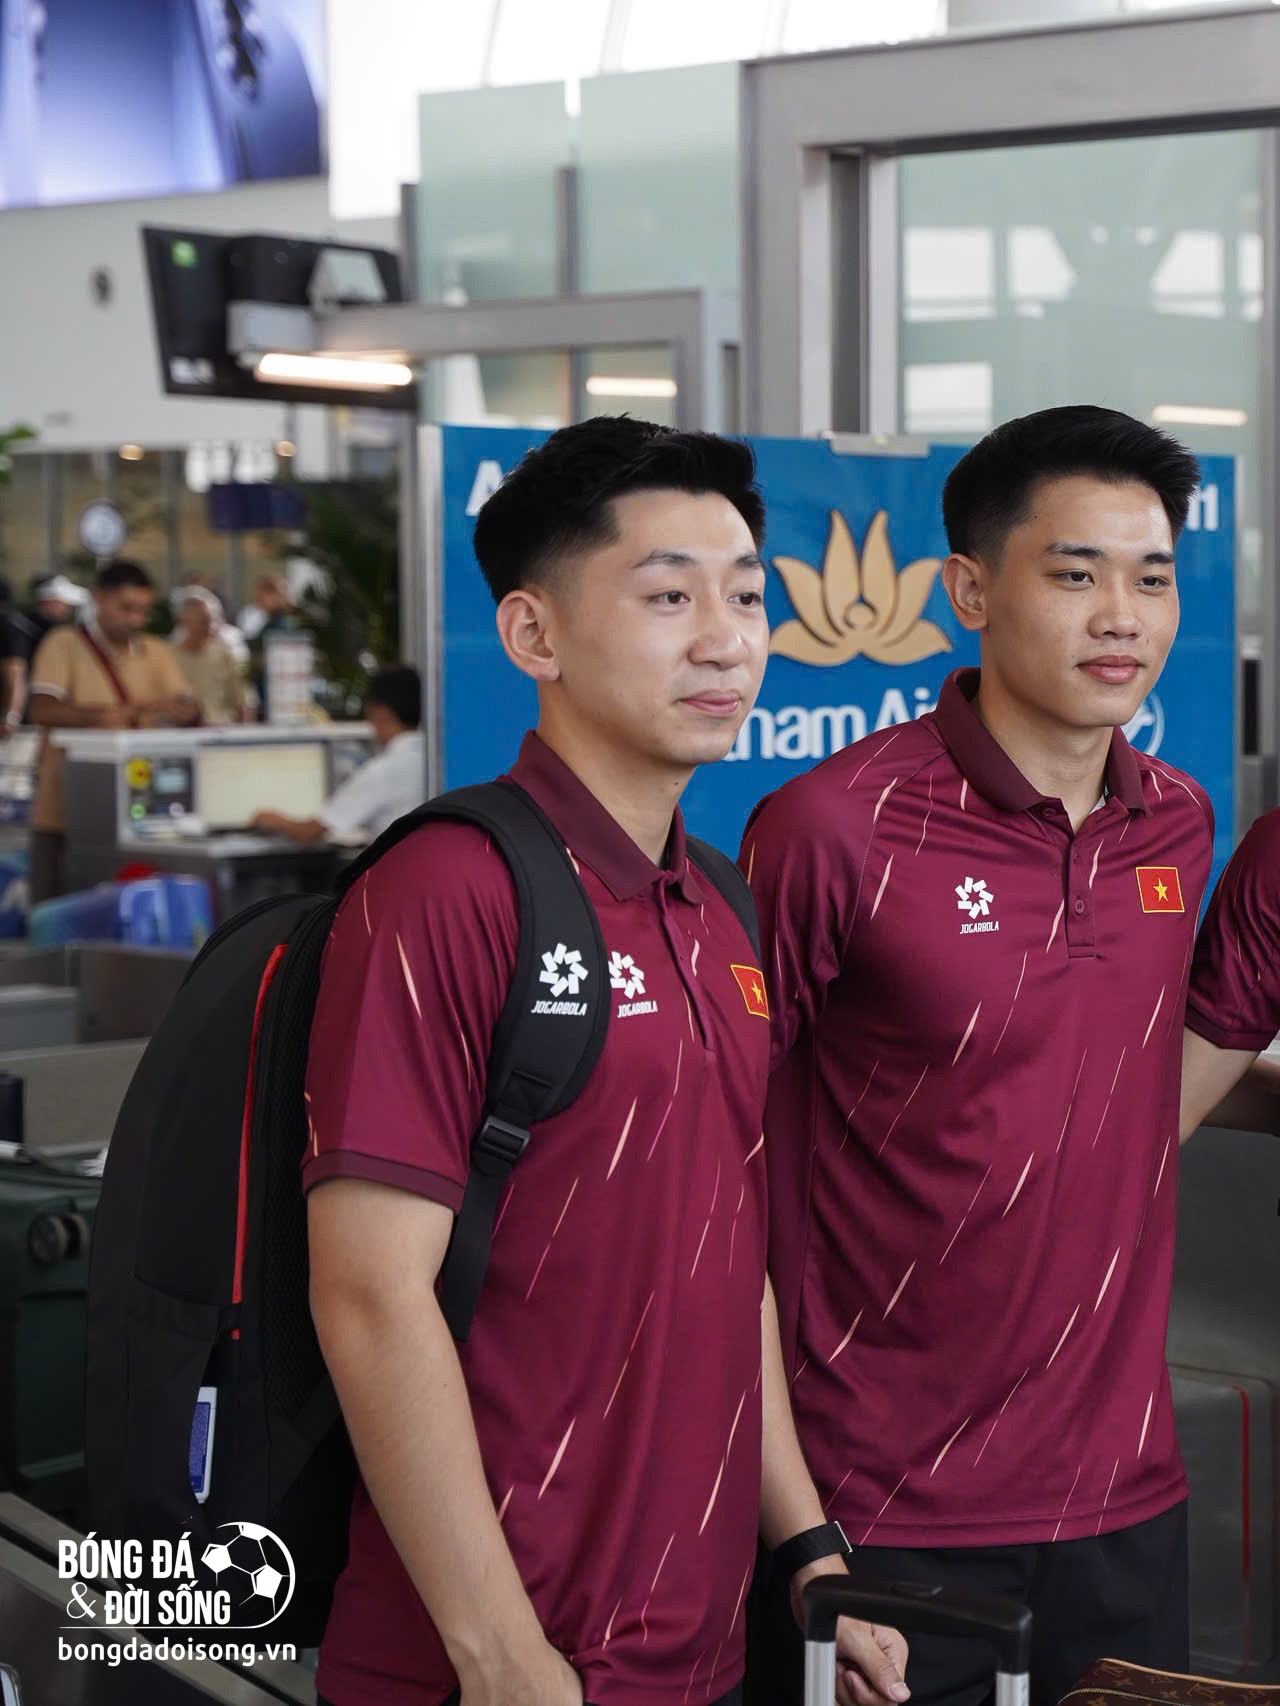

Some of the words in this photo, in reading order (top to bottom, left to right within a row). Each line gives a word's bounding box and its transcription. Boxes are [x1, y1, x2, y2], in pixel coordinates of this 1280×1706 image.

[722, 704, 867, 762] nam
[959, 920, 999, 934] JOGARBOLA
[531, 1000, 588, 1016] JOGARBOLA
[617, 1000, 658, 1018] JOGARBOLA
